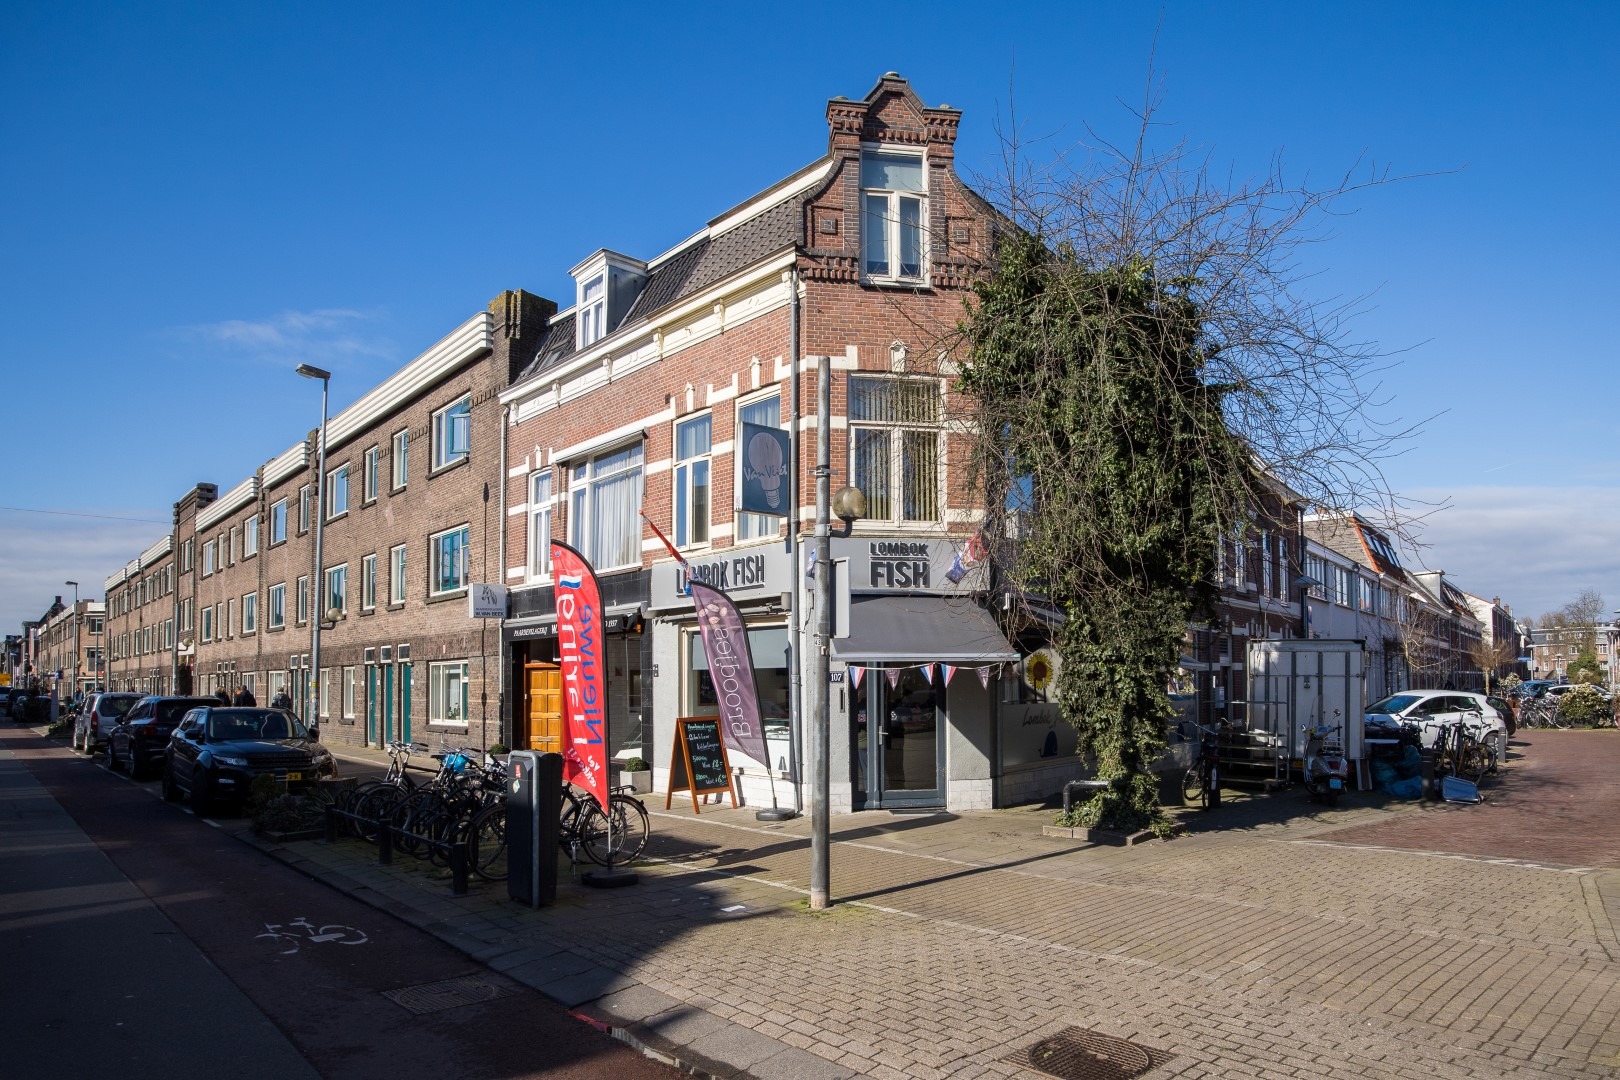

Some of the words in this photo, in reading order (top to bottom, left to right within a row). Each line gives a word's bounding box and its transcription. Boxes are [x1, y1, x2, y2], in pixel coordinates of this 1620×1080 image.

[868, 541, 930, 557] LOMBOK
[733, 554, 765, 586] FISH
[869, 560, 931, 588] FISH
[830, 673, 842, 682] 107
